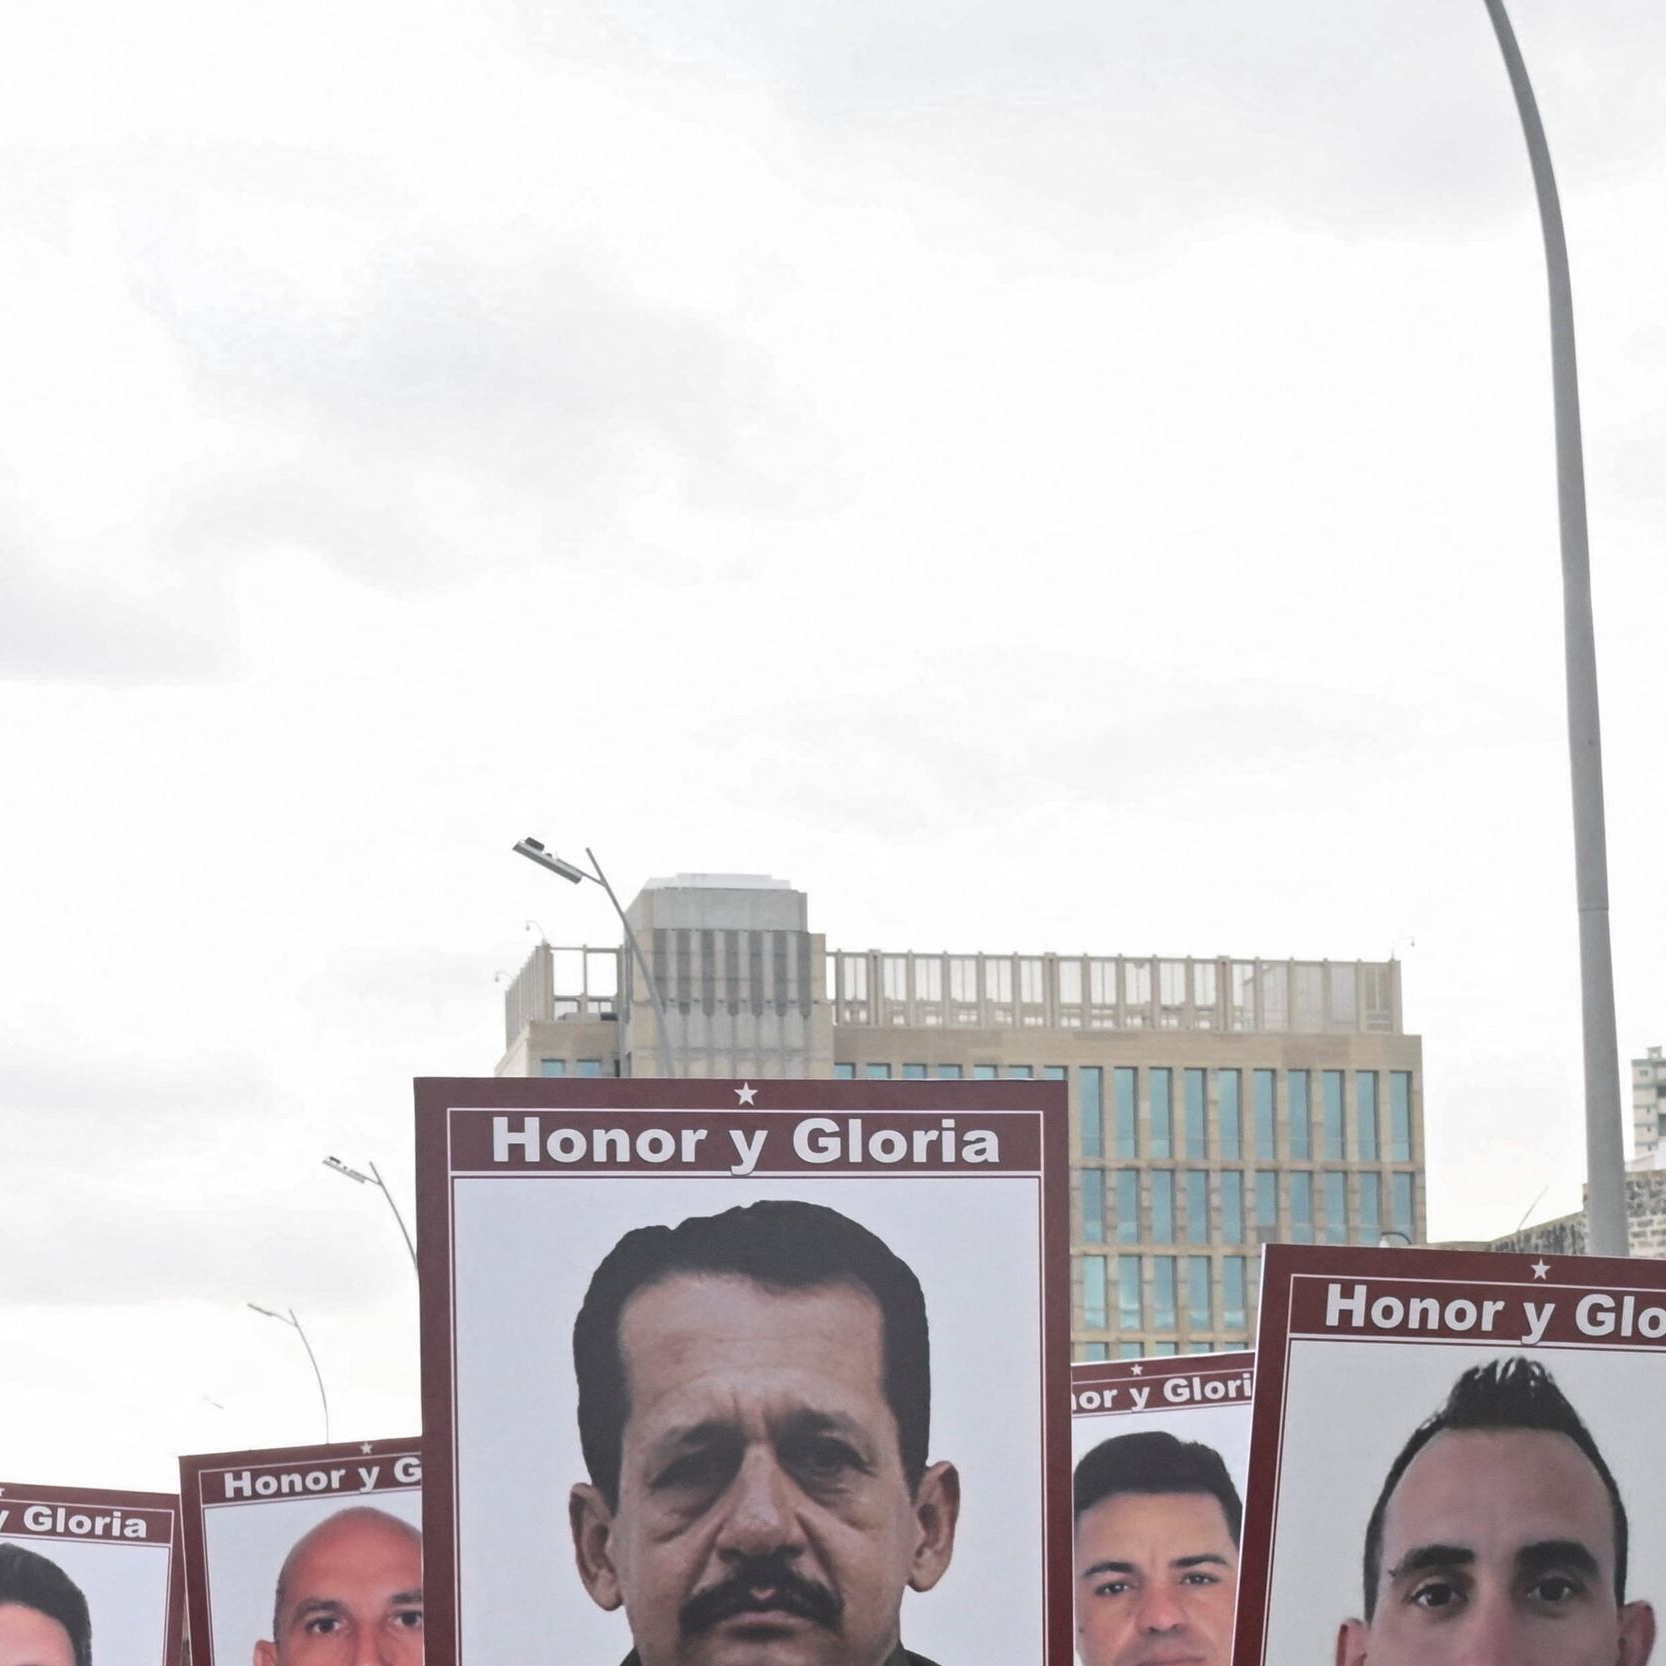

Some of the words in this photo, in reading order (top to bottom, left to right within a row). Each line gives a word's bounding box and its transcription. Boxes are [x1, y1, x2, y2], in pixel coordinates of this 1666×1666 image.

[493, 1117, 708, 1163] Honor
[729, 1129, 769, 1176] y
[793, 1118, 1000, 1164] Gloria
[1326, 1284, 1506, 1332] Honor
[1522, 1303, 1558, 1348] y
[1130, 1387, 1150, 1412] y
[1163, 1373, 1251, 1403] Glori
[223, 1470, 346, 1498] Honor
[358, 1465, 380, 1494] y
[394, 1456, 421, 1483] G
[24, 1506, 148, 1539] Gloria
